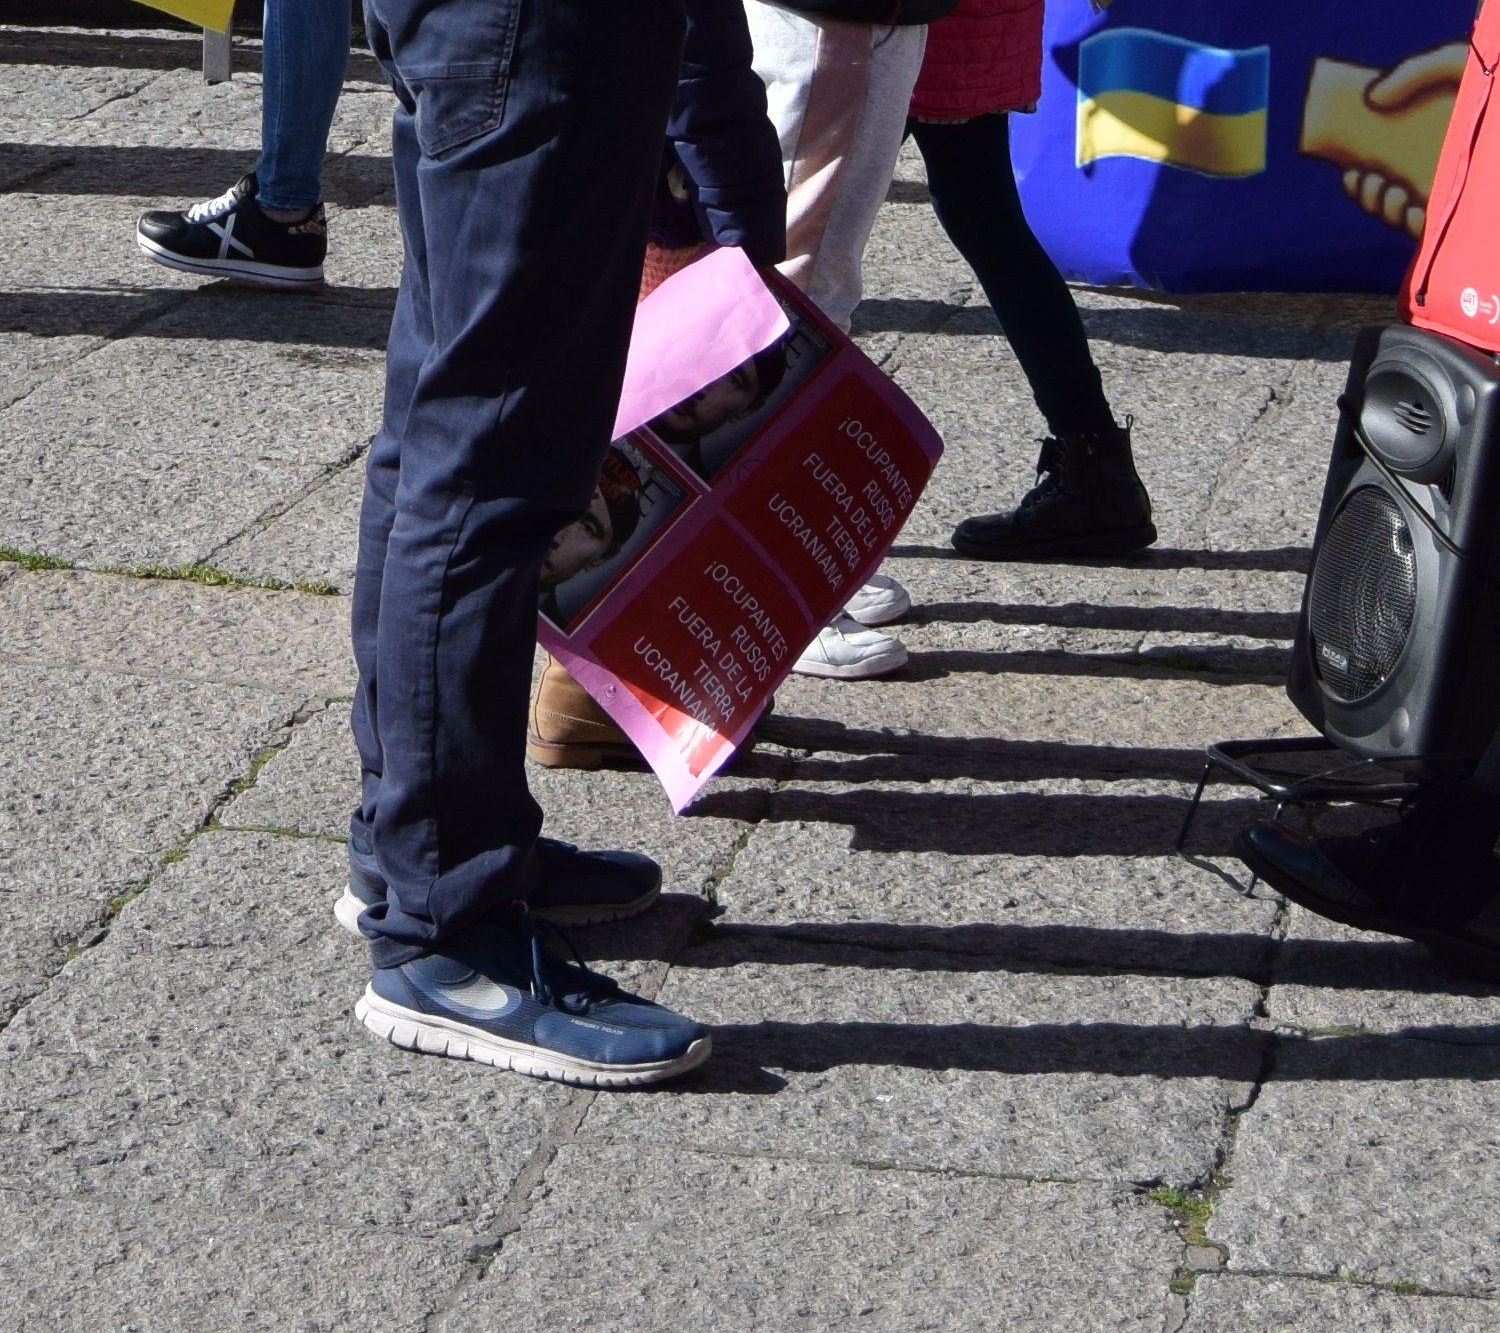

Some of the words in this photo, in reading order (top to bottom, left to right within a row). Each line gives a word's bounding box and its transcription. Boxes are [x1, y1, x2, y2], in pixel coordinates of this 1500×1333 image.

[802, 452, 855, 513] FUERA
[850, 507, 872, 533] DE
[862, 527, 878, 551] LA
[838, 417, 913, 511] ¡OCUPANTES
[825, 515, 862, 573] TIERRA
[862, 479, 896, 531] RUSOS
[667, 595, 722, 658] FUERA
[718, 652, 743, 681] DE
[735, 676, 754, 704] LA
[703, 561, 788, 662] ¡OCUPANTES
[693, 658, 736, 724] TIERRA
[730, 624, 772, 682] RUSOS
